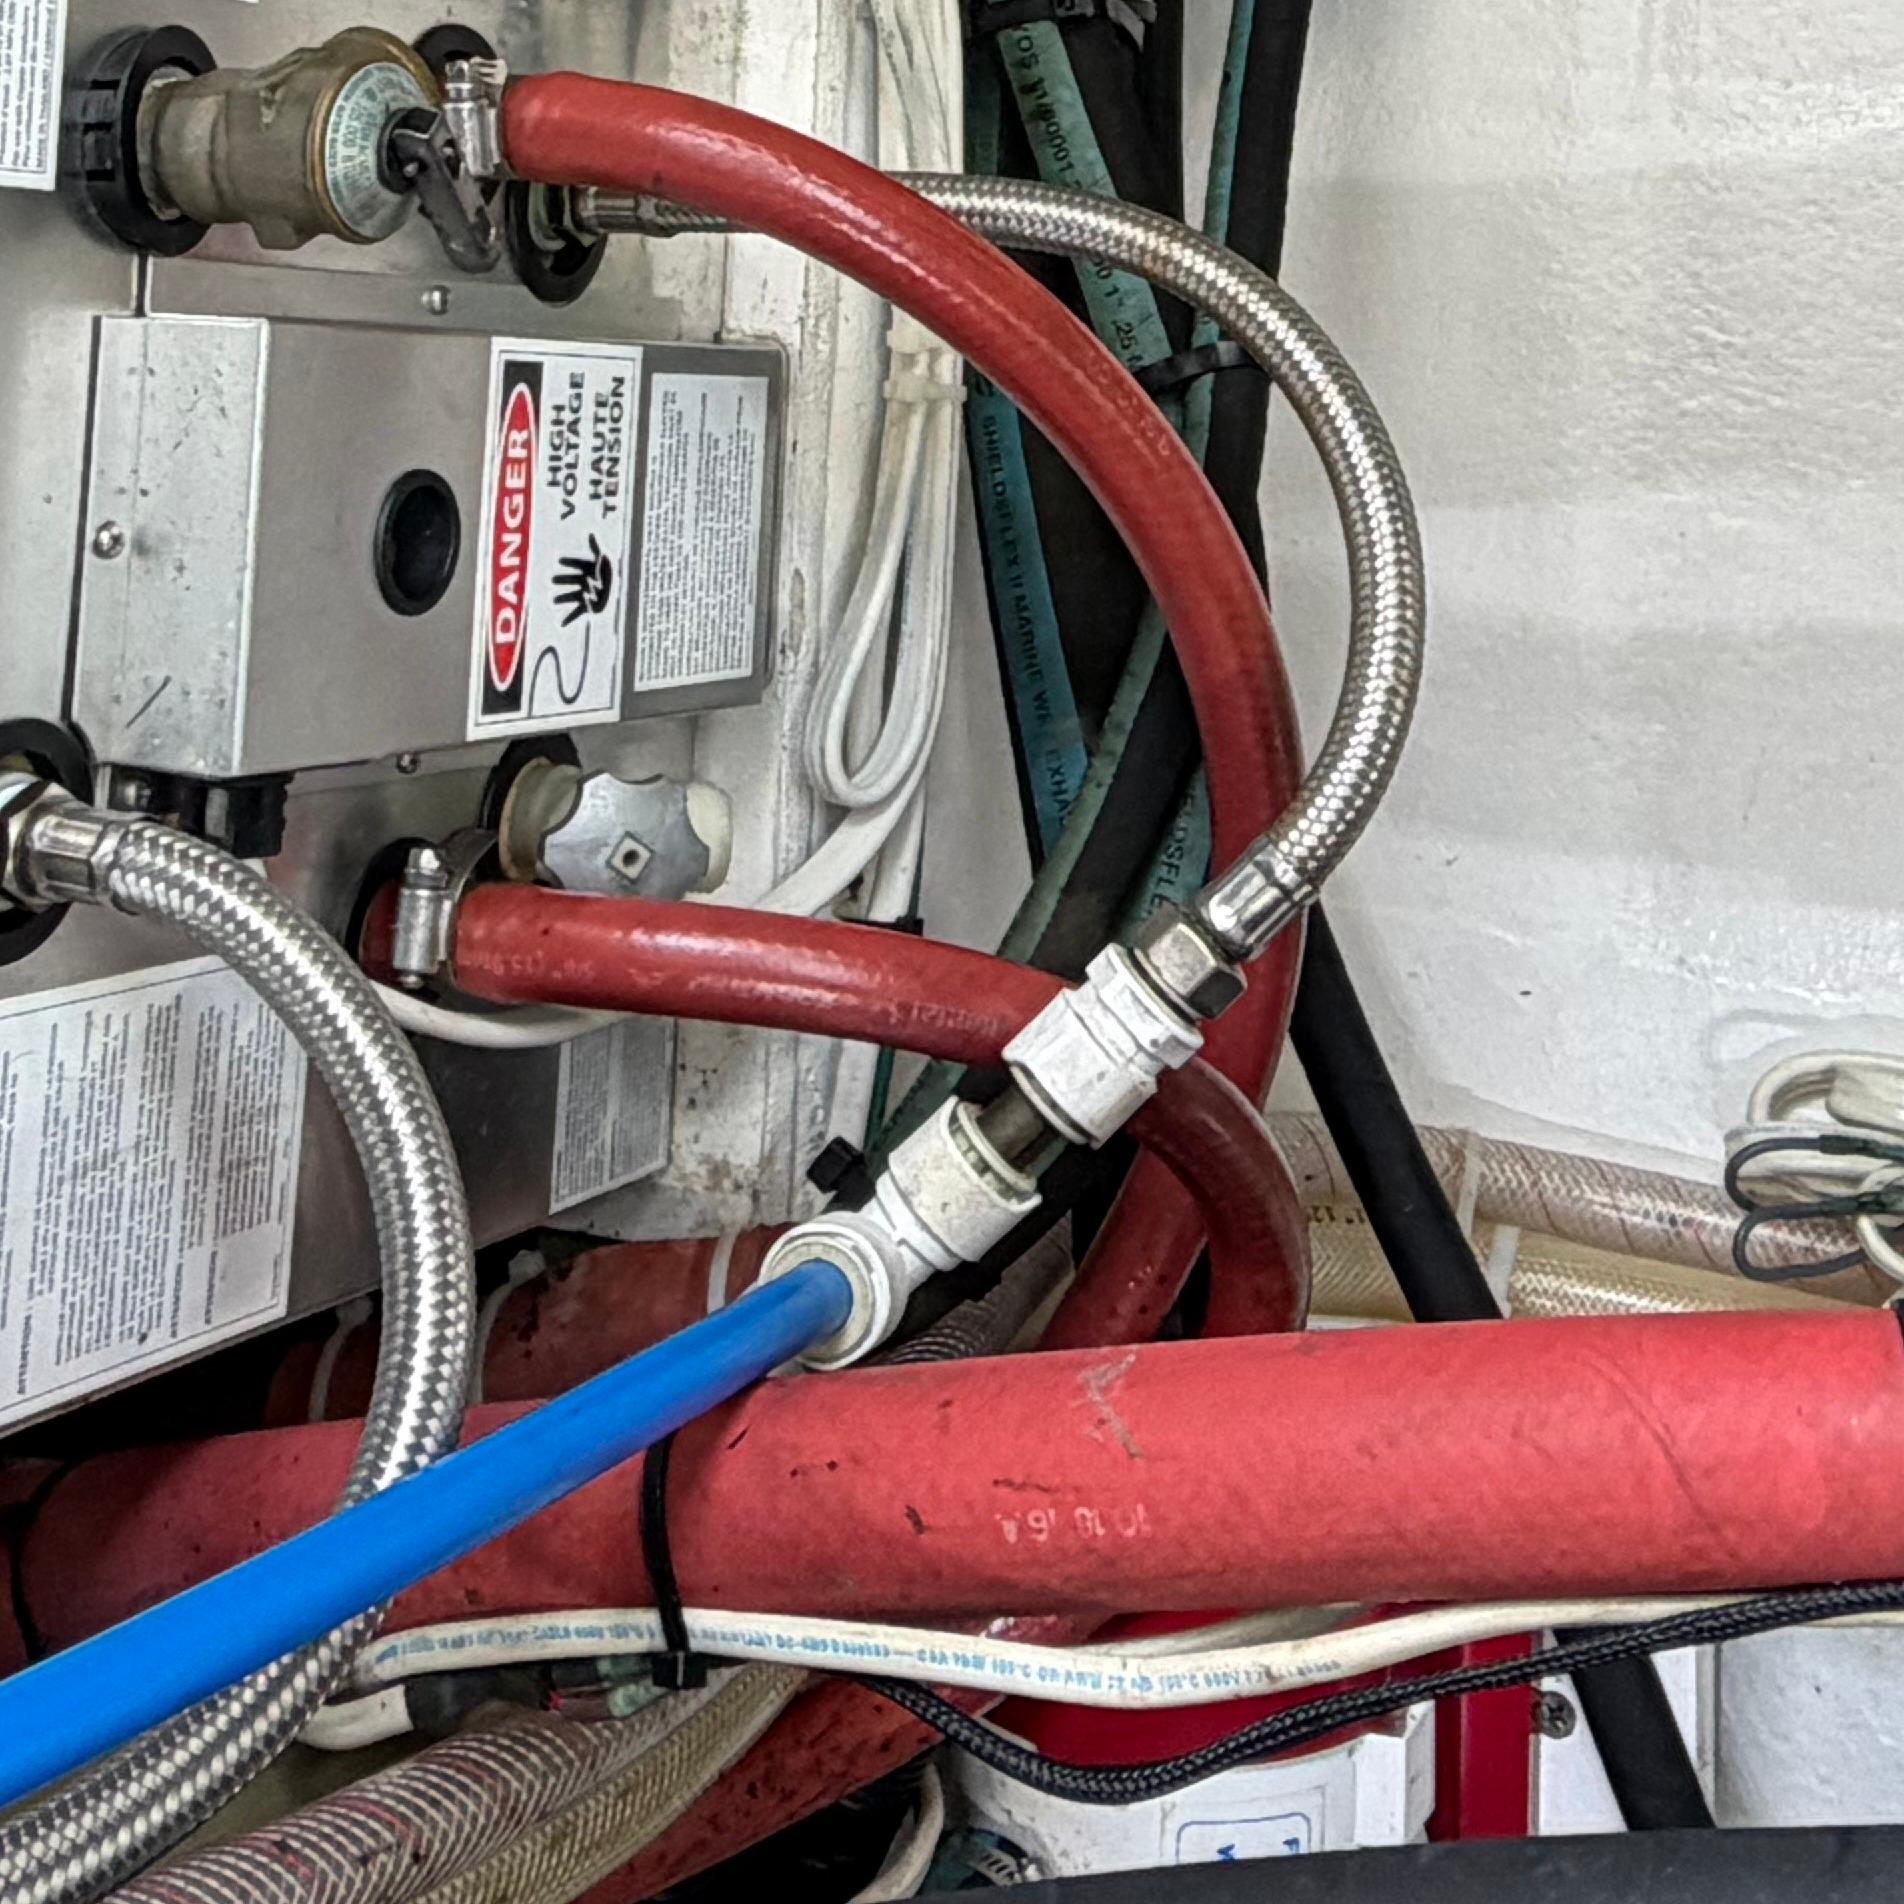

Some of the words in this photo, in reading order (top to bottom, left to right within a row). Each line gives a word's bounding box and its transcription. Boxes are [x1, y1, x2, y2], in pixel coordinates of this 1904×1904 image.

[547, 403, 566, 488] HIGH
[560, 371, 586, 522] VOLTAGE
[589, 391, 608, 502] HAUTE
[602, 375, 627, 520] TENSION
[494, 425, 533, 645] DANGER
